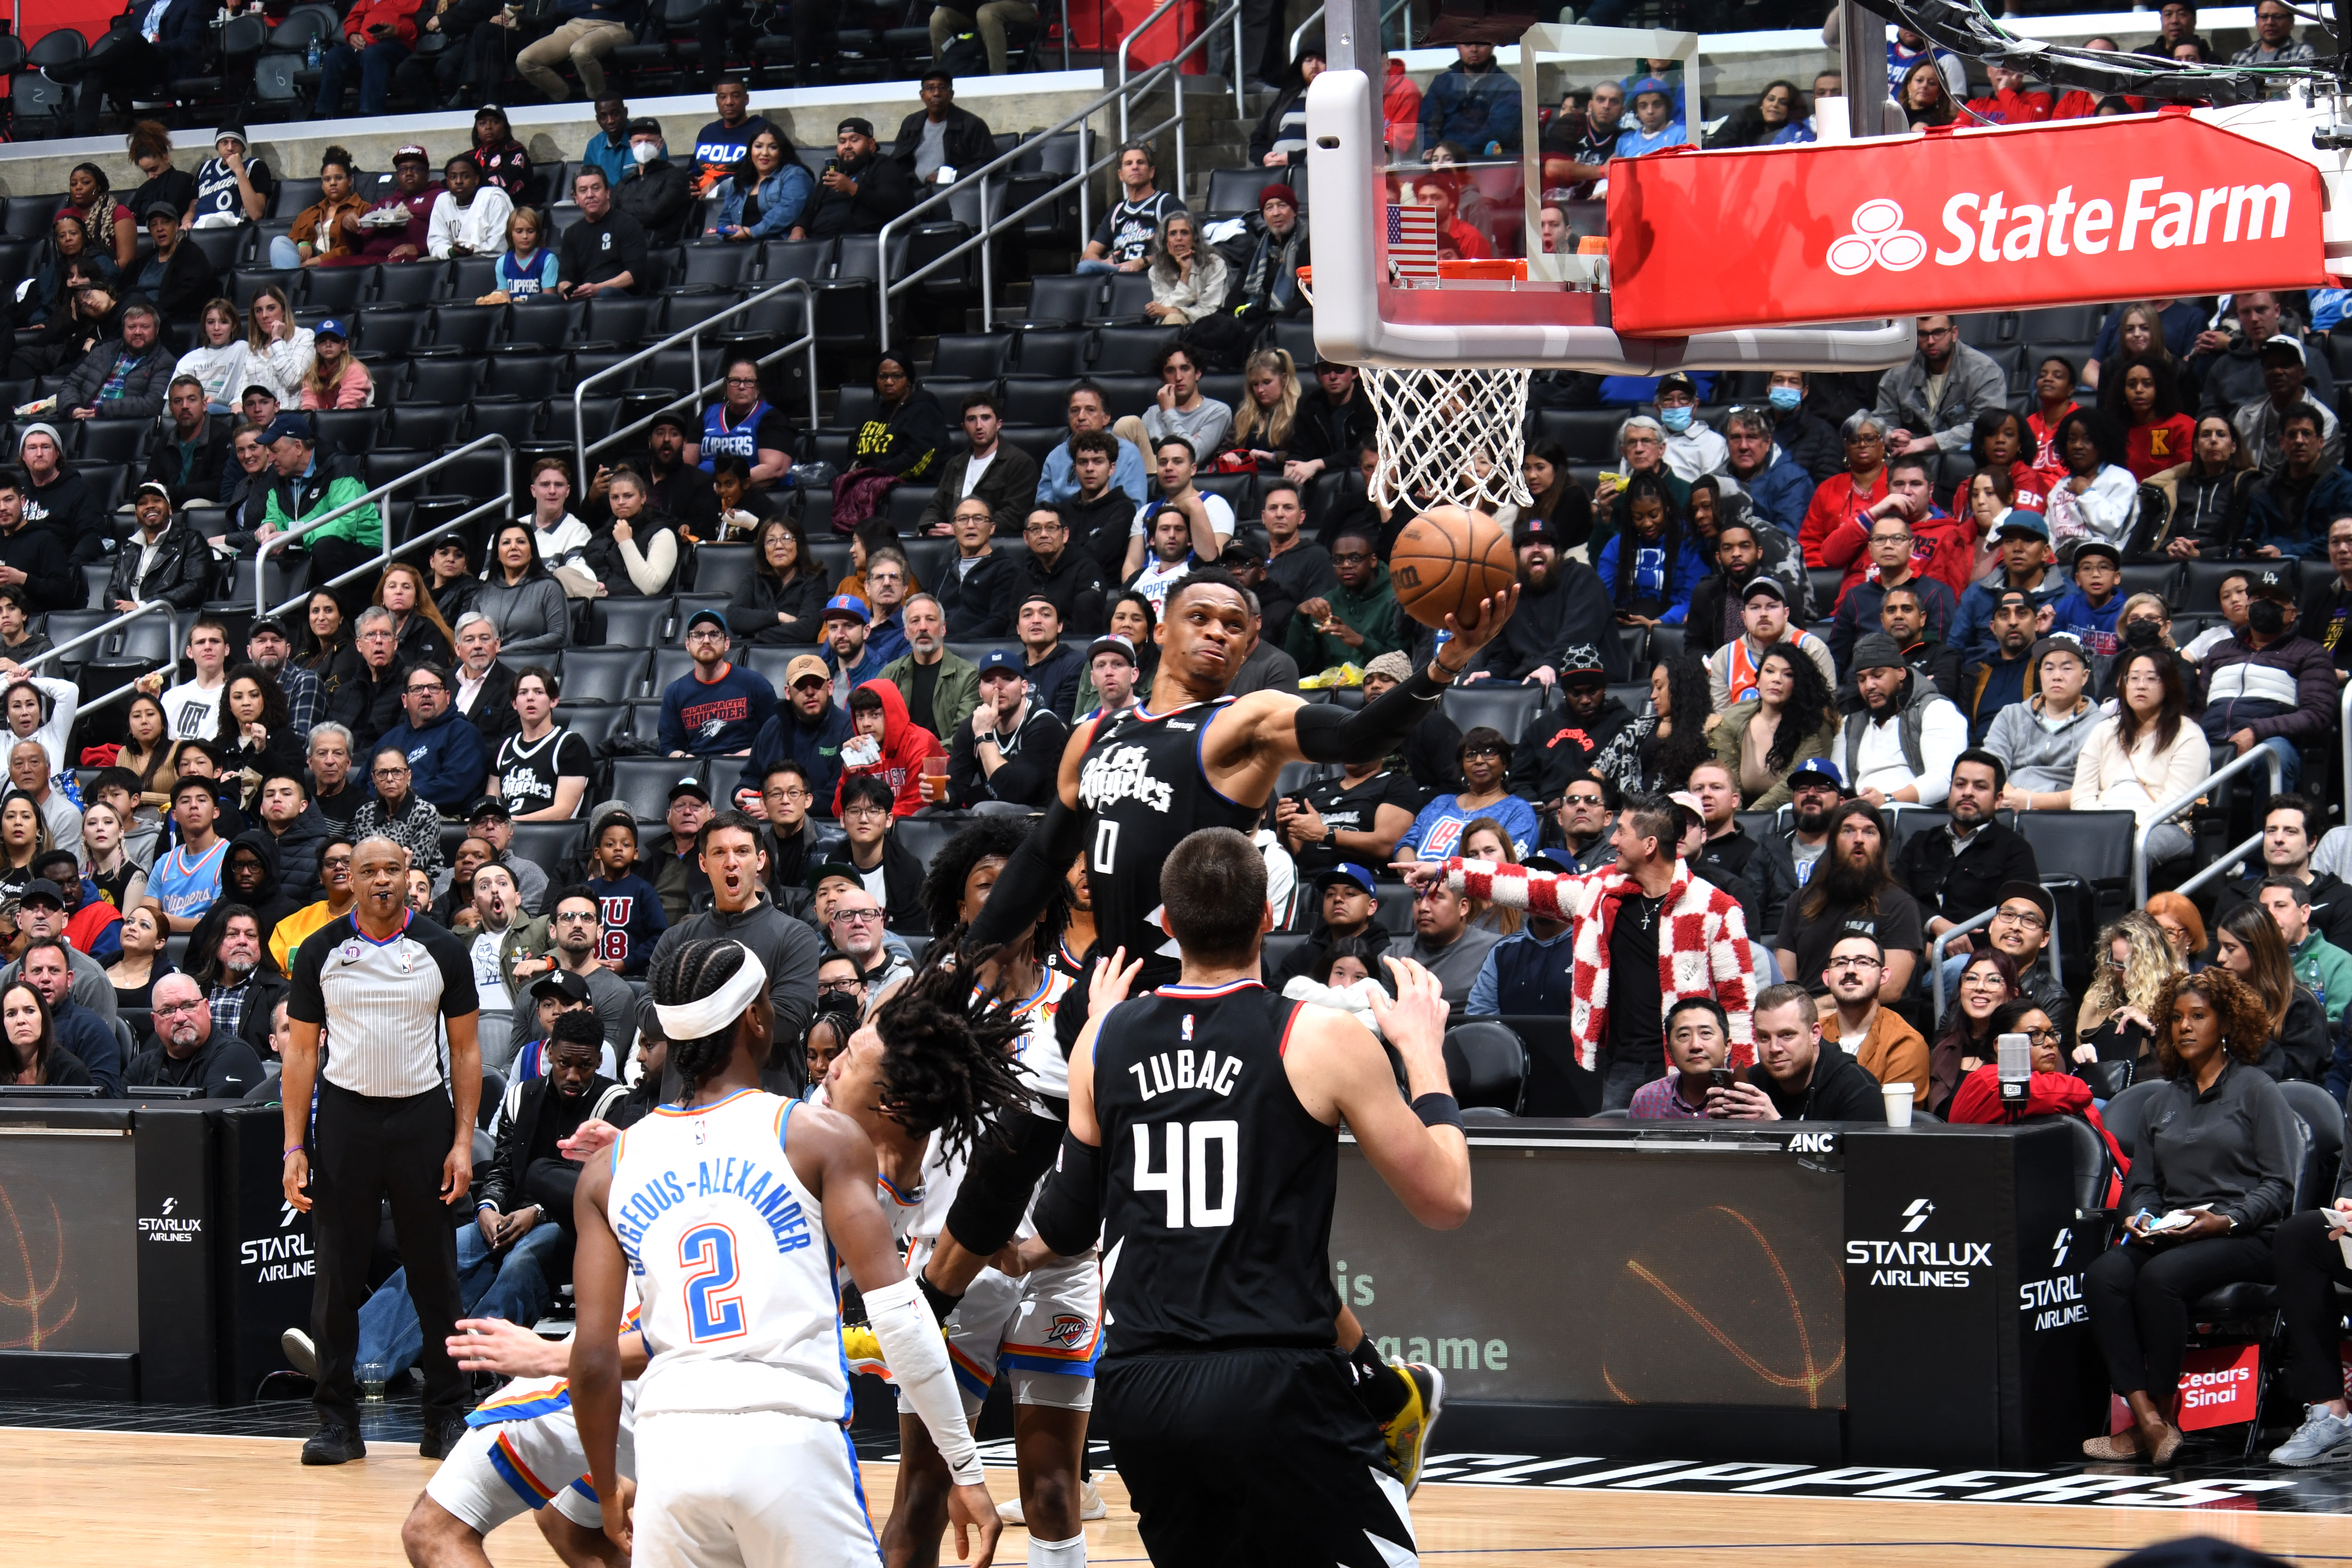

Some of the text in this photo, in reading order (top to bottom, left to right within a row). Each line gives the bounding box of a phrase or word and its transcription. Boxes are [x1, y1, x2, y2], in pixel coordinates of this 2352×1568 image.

[276, 69, 285, 86] 6
[33, 88, 44, 102] 2
[696, 144, 747, 163] POLO
[216, 190, 232, 210] 0
[507, 278, 540, 294] CLIPPERS
[702, 436, 755, 456] CLIPPERS
[2151, 429, 2170, 455] K
[2261, 571, 2278, 585] LA
[681, 698, 747, 717] OKLAHOMA CITY
[683, 706, 747, 729] THUNDER
[1166, 718, 1197, 731] honey
[1100, 742, 1144, 773] Los
[509, 768, 534, 783] Los
[502, 775, 552, 801] Angeles
[1079, 760, 1175, 813] Angeles
[1094, 819, 1119, 874] 0
[162, 888, 213, 918] Clippers
[349, 948, 358, 958] TB
[1048, 954, 1057, 966] 6
[551, 970, 564, 983] LA
[1129, 1050, 1243, 1102] ZUBAC
[1787, 1134, 1833, 1152] ANC
[1133, 1120, 1238, 1229] 40
[139, 1218, 202, 1231] STARLUX
[149, 1233, 192, 1242] AIRLINES
[241, 1233, 315, 1265] STARL
[1846, 1240, 1992, 1267] STARLUX
[258, 1259, 316, 1283] AIRLINE
[1870, 1270, 1969, 1287] AIRLINES
[679, 1222, 748, 1344] 2
[1336, 1260, 1375, 1307] is
[2020, 1272, 2085, 1311] STARL
[1377, 1335, 1509, 1372] game
[2185, 1385, 2236, 1409] Sinai
